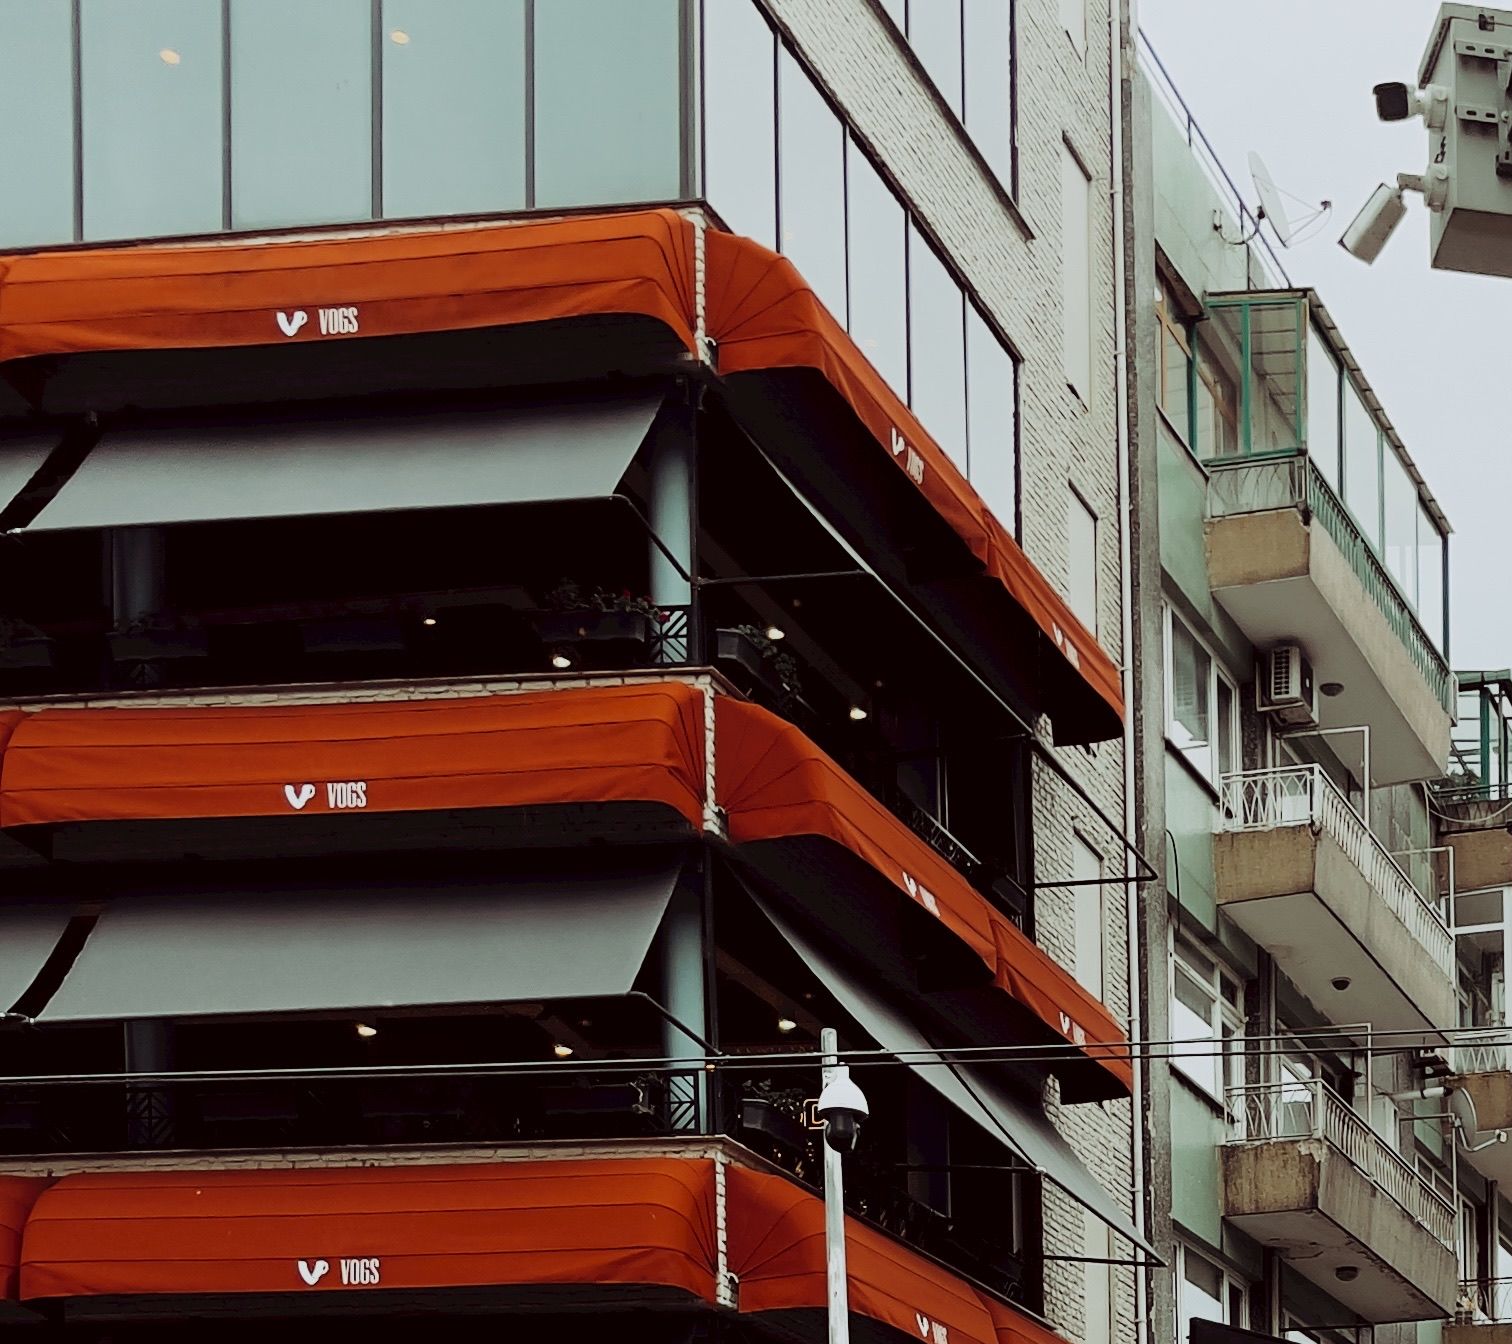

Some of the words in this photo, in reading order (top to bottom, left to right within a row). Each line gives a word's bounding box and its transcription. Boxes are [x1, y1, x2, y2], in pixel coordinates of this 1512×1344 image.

[317, 306, 359, 336] VOGS
[326, 781, 367, 809] VOGS
[340, 1257, 380, 1286] VOGS
